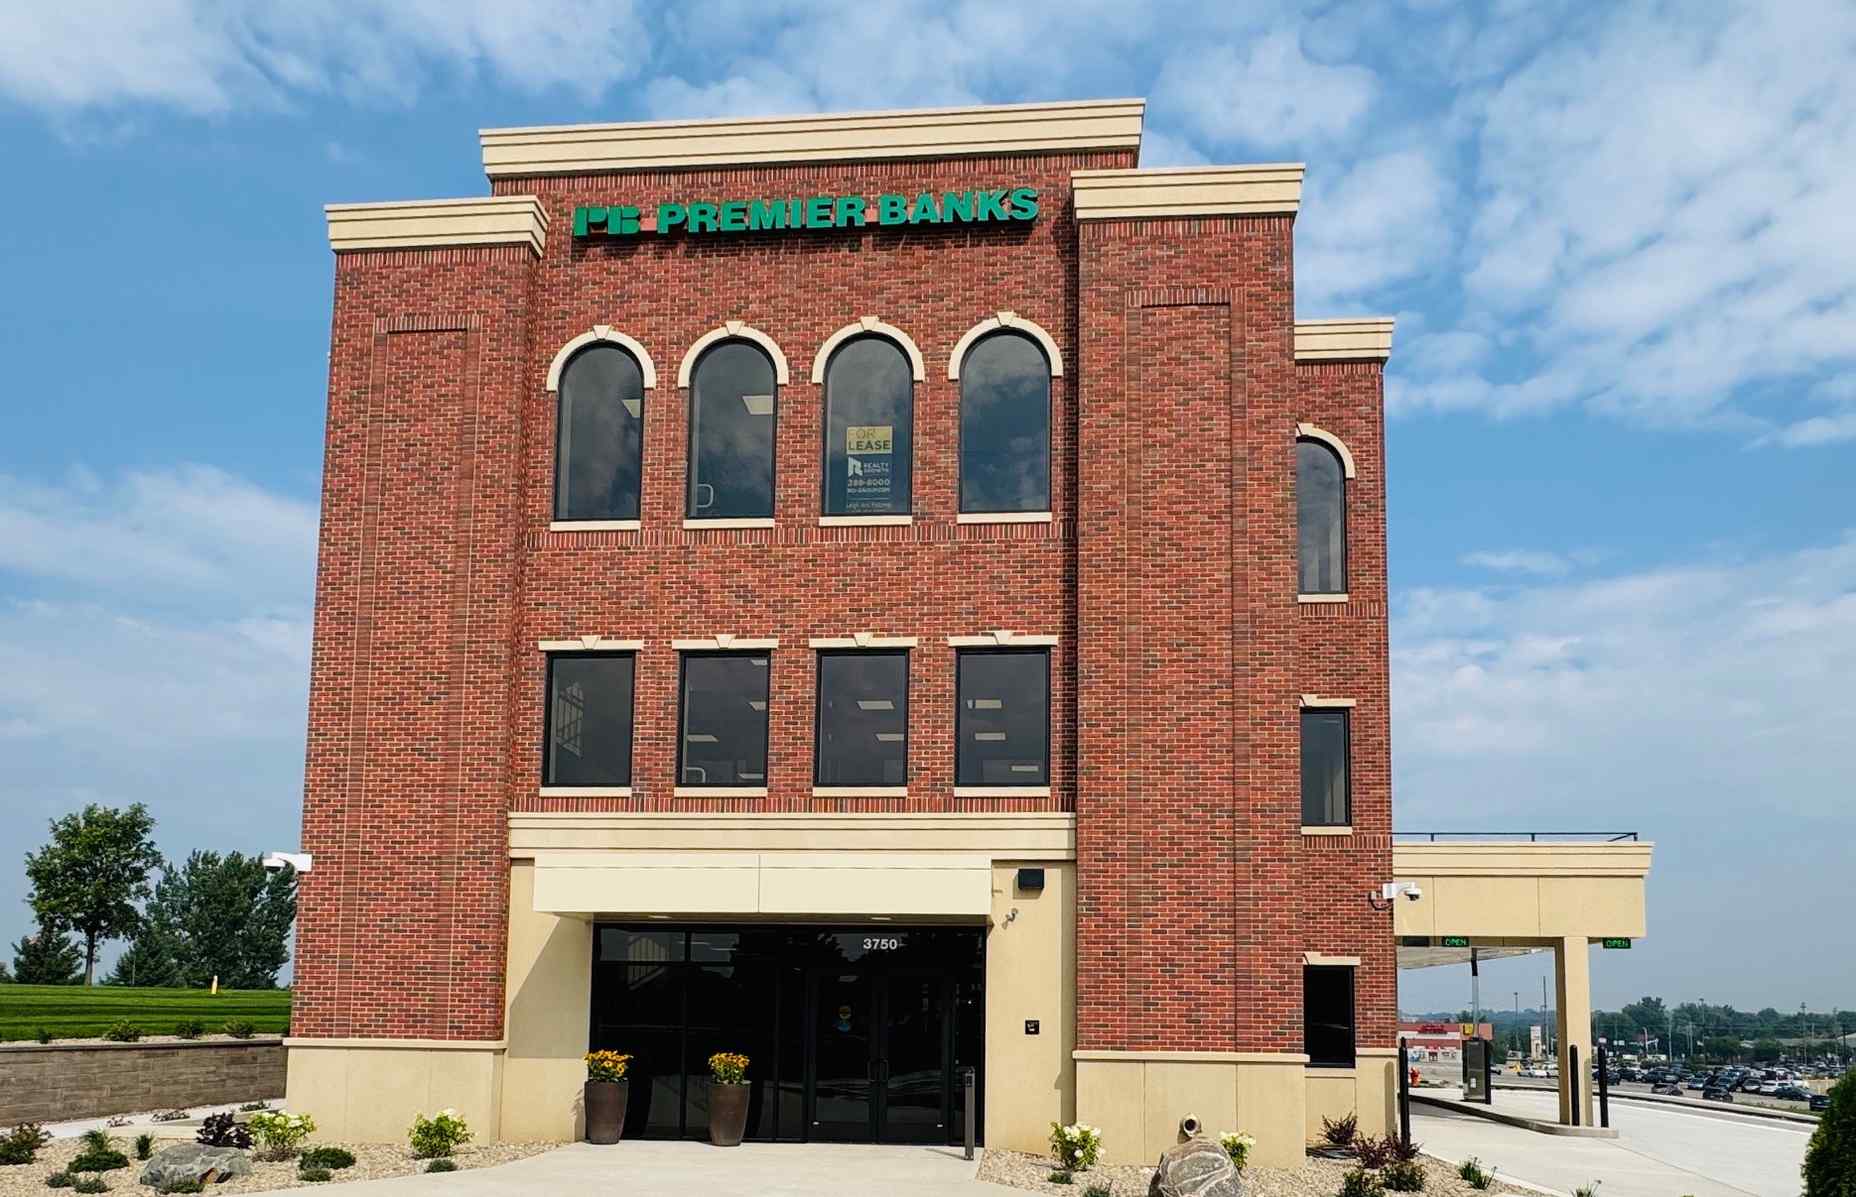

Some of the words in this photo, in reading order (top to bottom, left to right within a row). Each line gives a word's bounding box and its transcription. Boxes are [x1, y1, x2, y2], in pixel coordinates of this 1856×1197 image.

[657, 197, 866, 233] PREMIER
[880, 188, 1039, 225] BANKS
[848, 440, 891, 450] LEASE
[863, 938, 898, 949] 3750
